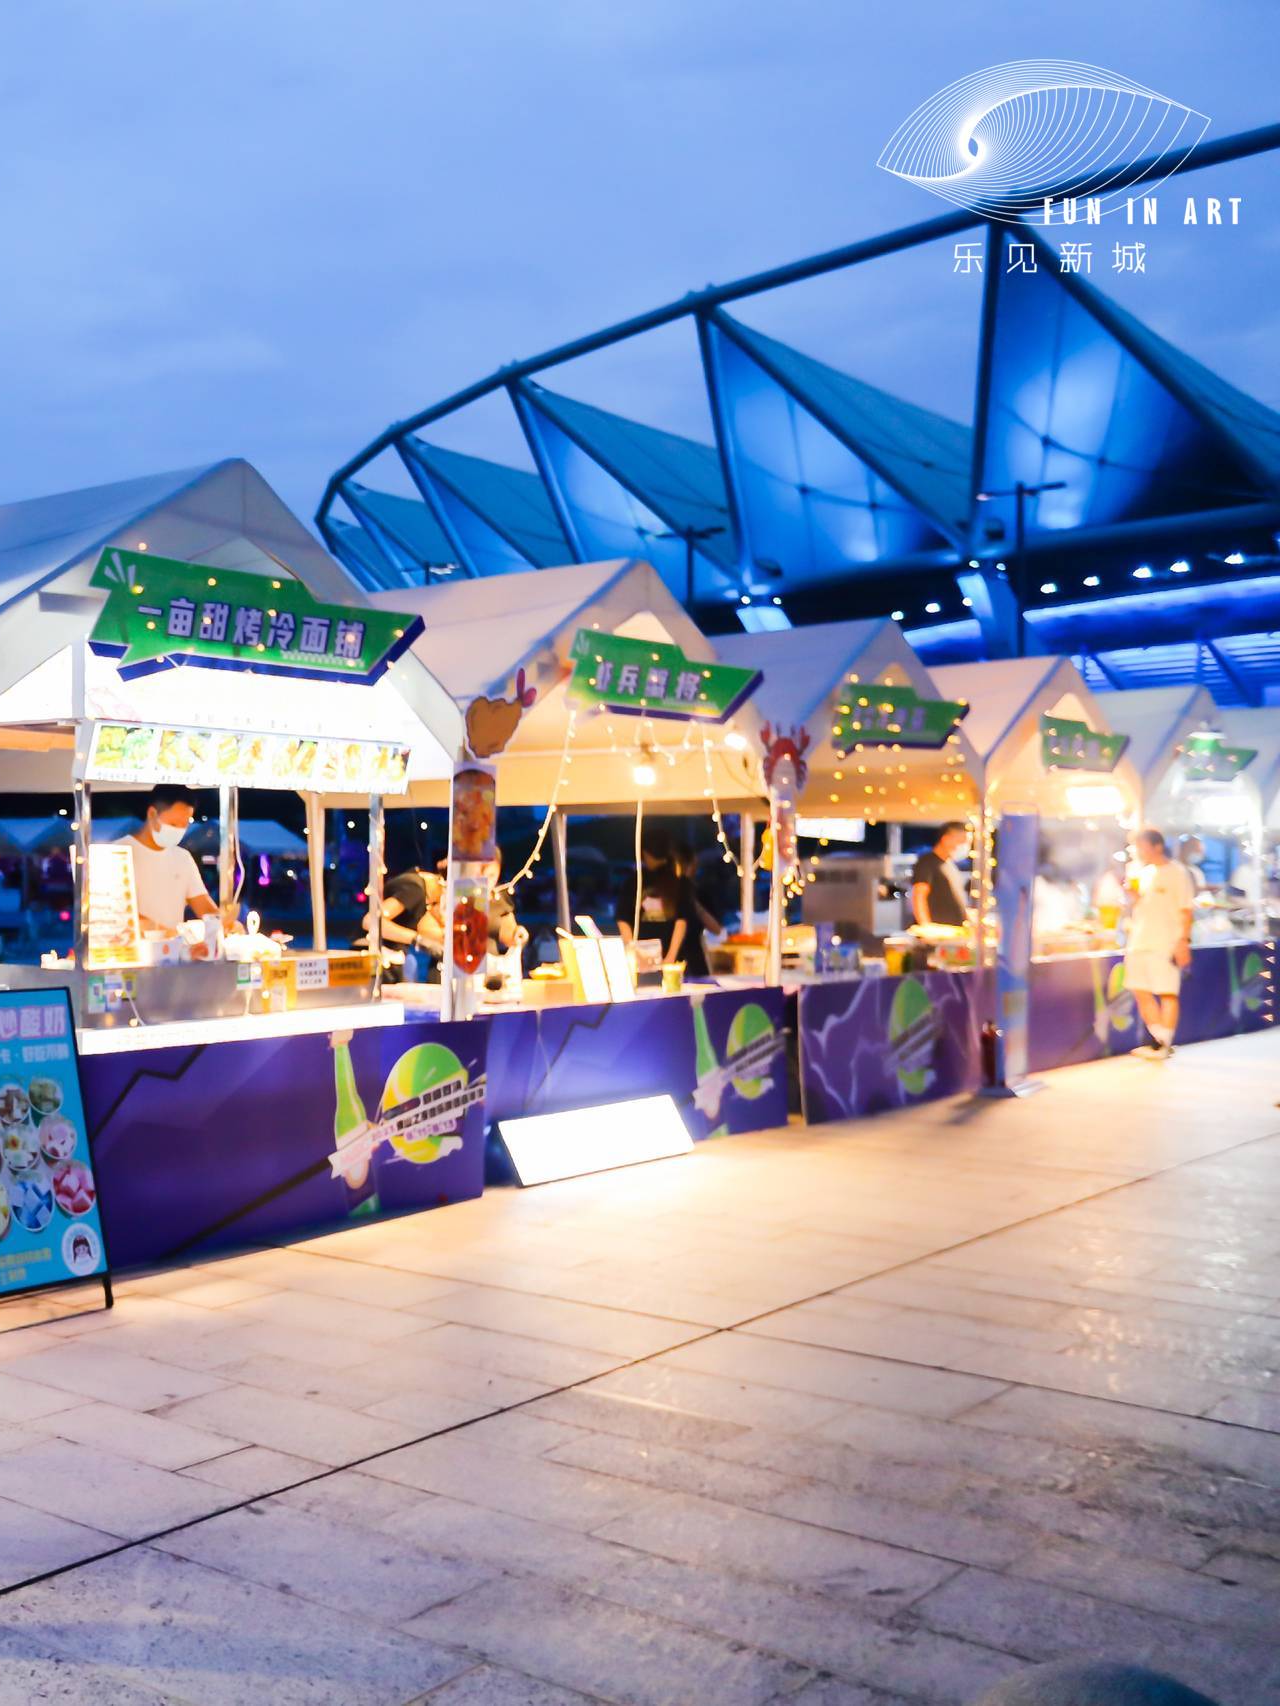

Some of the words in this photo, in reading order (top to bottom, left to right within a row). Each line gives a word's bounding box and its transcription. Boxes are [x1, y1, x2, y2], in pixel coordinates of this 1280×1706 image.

[138, 597, 365, 659] 一亩甜烤冷面铺
